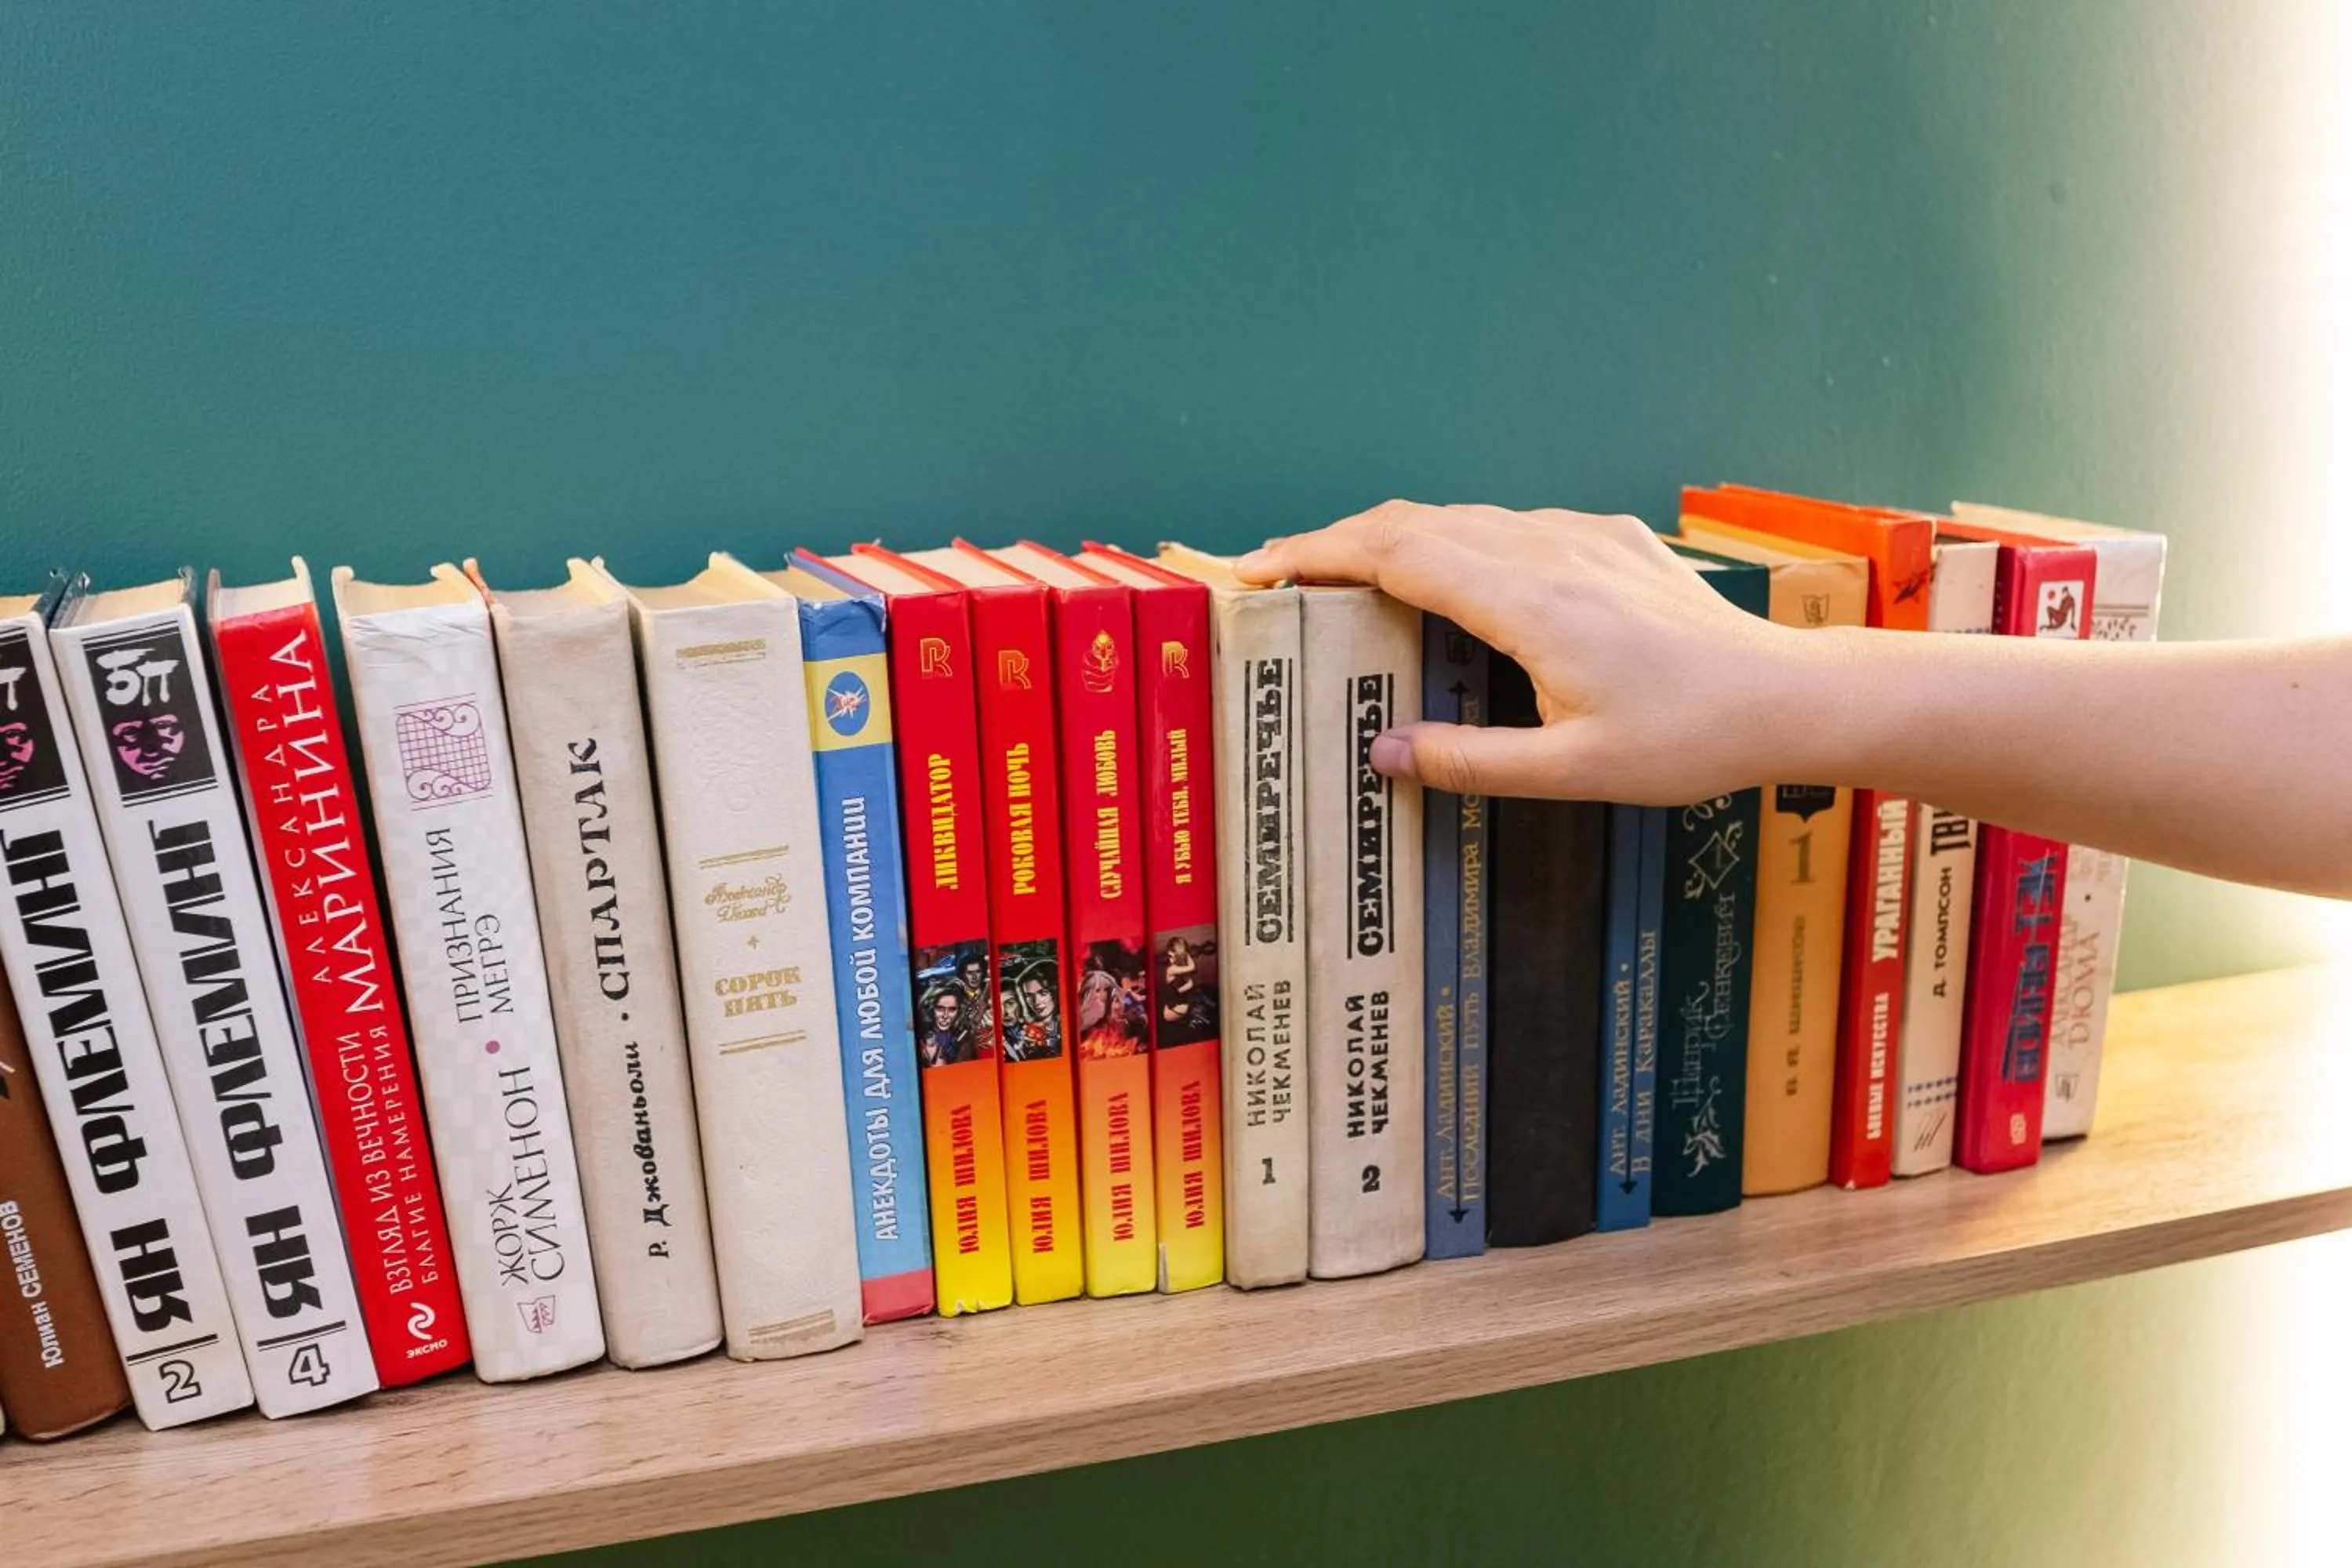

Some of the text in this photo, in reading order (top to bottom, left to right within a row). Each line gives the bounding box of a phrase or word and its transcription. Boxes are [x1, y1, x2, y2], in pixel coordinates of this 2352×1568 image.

[252, 684, 332, 983] АЛЕКСАНДРА
[270, 632, 384, 1014] МАРИНИНА
[567, 737, 630, 1001] СПАРТАК
[928, 753, 959, 890] ЛИКВИДАТОР
[1006, 742, 1036, 895] РОКОВАЯ НОЧЬ
[1093, 729, 1122, 899] СЛУЧАЙНАЯ ЛЮБОВЬ
[1167, 729, 1192, 884] Я УБЬЮ ТЕБЯ, МИЛЫЙ
[1256, 658, 1283, 943] СЕМИРЕЧЬЕ
[1790, 833, 1815, 884] 1
[426, 828, 482, 1023] ПРИЗНАНИЯ
[474, 914, 514, 1013] МЕГРЭ
[714, 966, 802, 996] СОРОК
[1462, 841, 1480, 979] Владимира
[1867, 800, 1907, 1139] БОЕВЫЕ ИСКУССТВА УРАГАННЫЙ
[1936, 867, 1951, 969] ТОМПСОН
[724, 989, 797, 1017] ПЯТЬ
[841, 795, 898, 1240] АНЕКДОТЫ ДЛЯ ЛЮБОЙ КОМПАНИИ
[1243, 983, 1266, 1127] НИКОЛАЙ
[1272, 979, 1291, 1123] ЧЕКМЕНЕВ
[1370, 990, 1389, 1134] ЧЕКМЕНЕВ
[1465, 992, 1481, 1051] путь
[1612, 979, 1631, 1115] Ладинский
[1635, 931, 1657, 1074] Каракаллы
[2067, 932, 2100, 1050] ДЮМА
[0, 829, 193, 1332] ЯН ФЛЕМИНГ
[149, 820, 323, 1319] ЯН ФЛЕМИНГ
[625, 1041, 672, 1227] Джованьоли
[1345, 995, 1365, 1138] НИКОЛАЙ
[1464, 1064, 1481, 1202] Последний
[337, 1031, 413, 1295] ВЗГЛЯД ИЗ ВЕЧНОСТИ
[369, 1025, 441, 1285] БЛАГИЕ НАМЕРЕНИЯ
[499, 1066, 564, 1281] СИМЕНОН
[951, 1104, 979, 1254] ЮЛИЯ ШИЛОВА
[1026, 1099, 1054, 1254] ЮЛИЯ ШИЛОВА
[1108, 1091, 1134, 1241] ЮЛИЯ ШИЛОВА
[1181, 1080, 1205, 1229] ЮЛИЯ ШИЛОВА
[1261, 1158, 1276, 1185] 1
[1362, 1165, 1381, 1193] 2
[1631, 1156, 1650, 1174] В
[1, 1200, 64, 1369] Юлиан СЕМЕНОВ
[486, 1182, 528, 1287] ЖОРЖ
[160, 1359, 202, 1403] 2
[289, 1344, 331, 1387] 4
[406, 1339, 448, 1359] ЭКСМО
